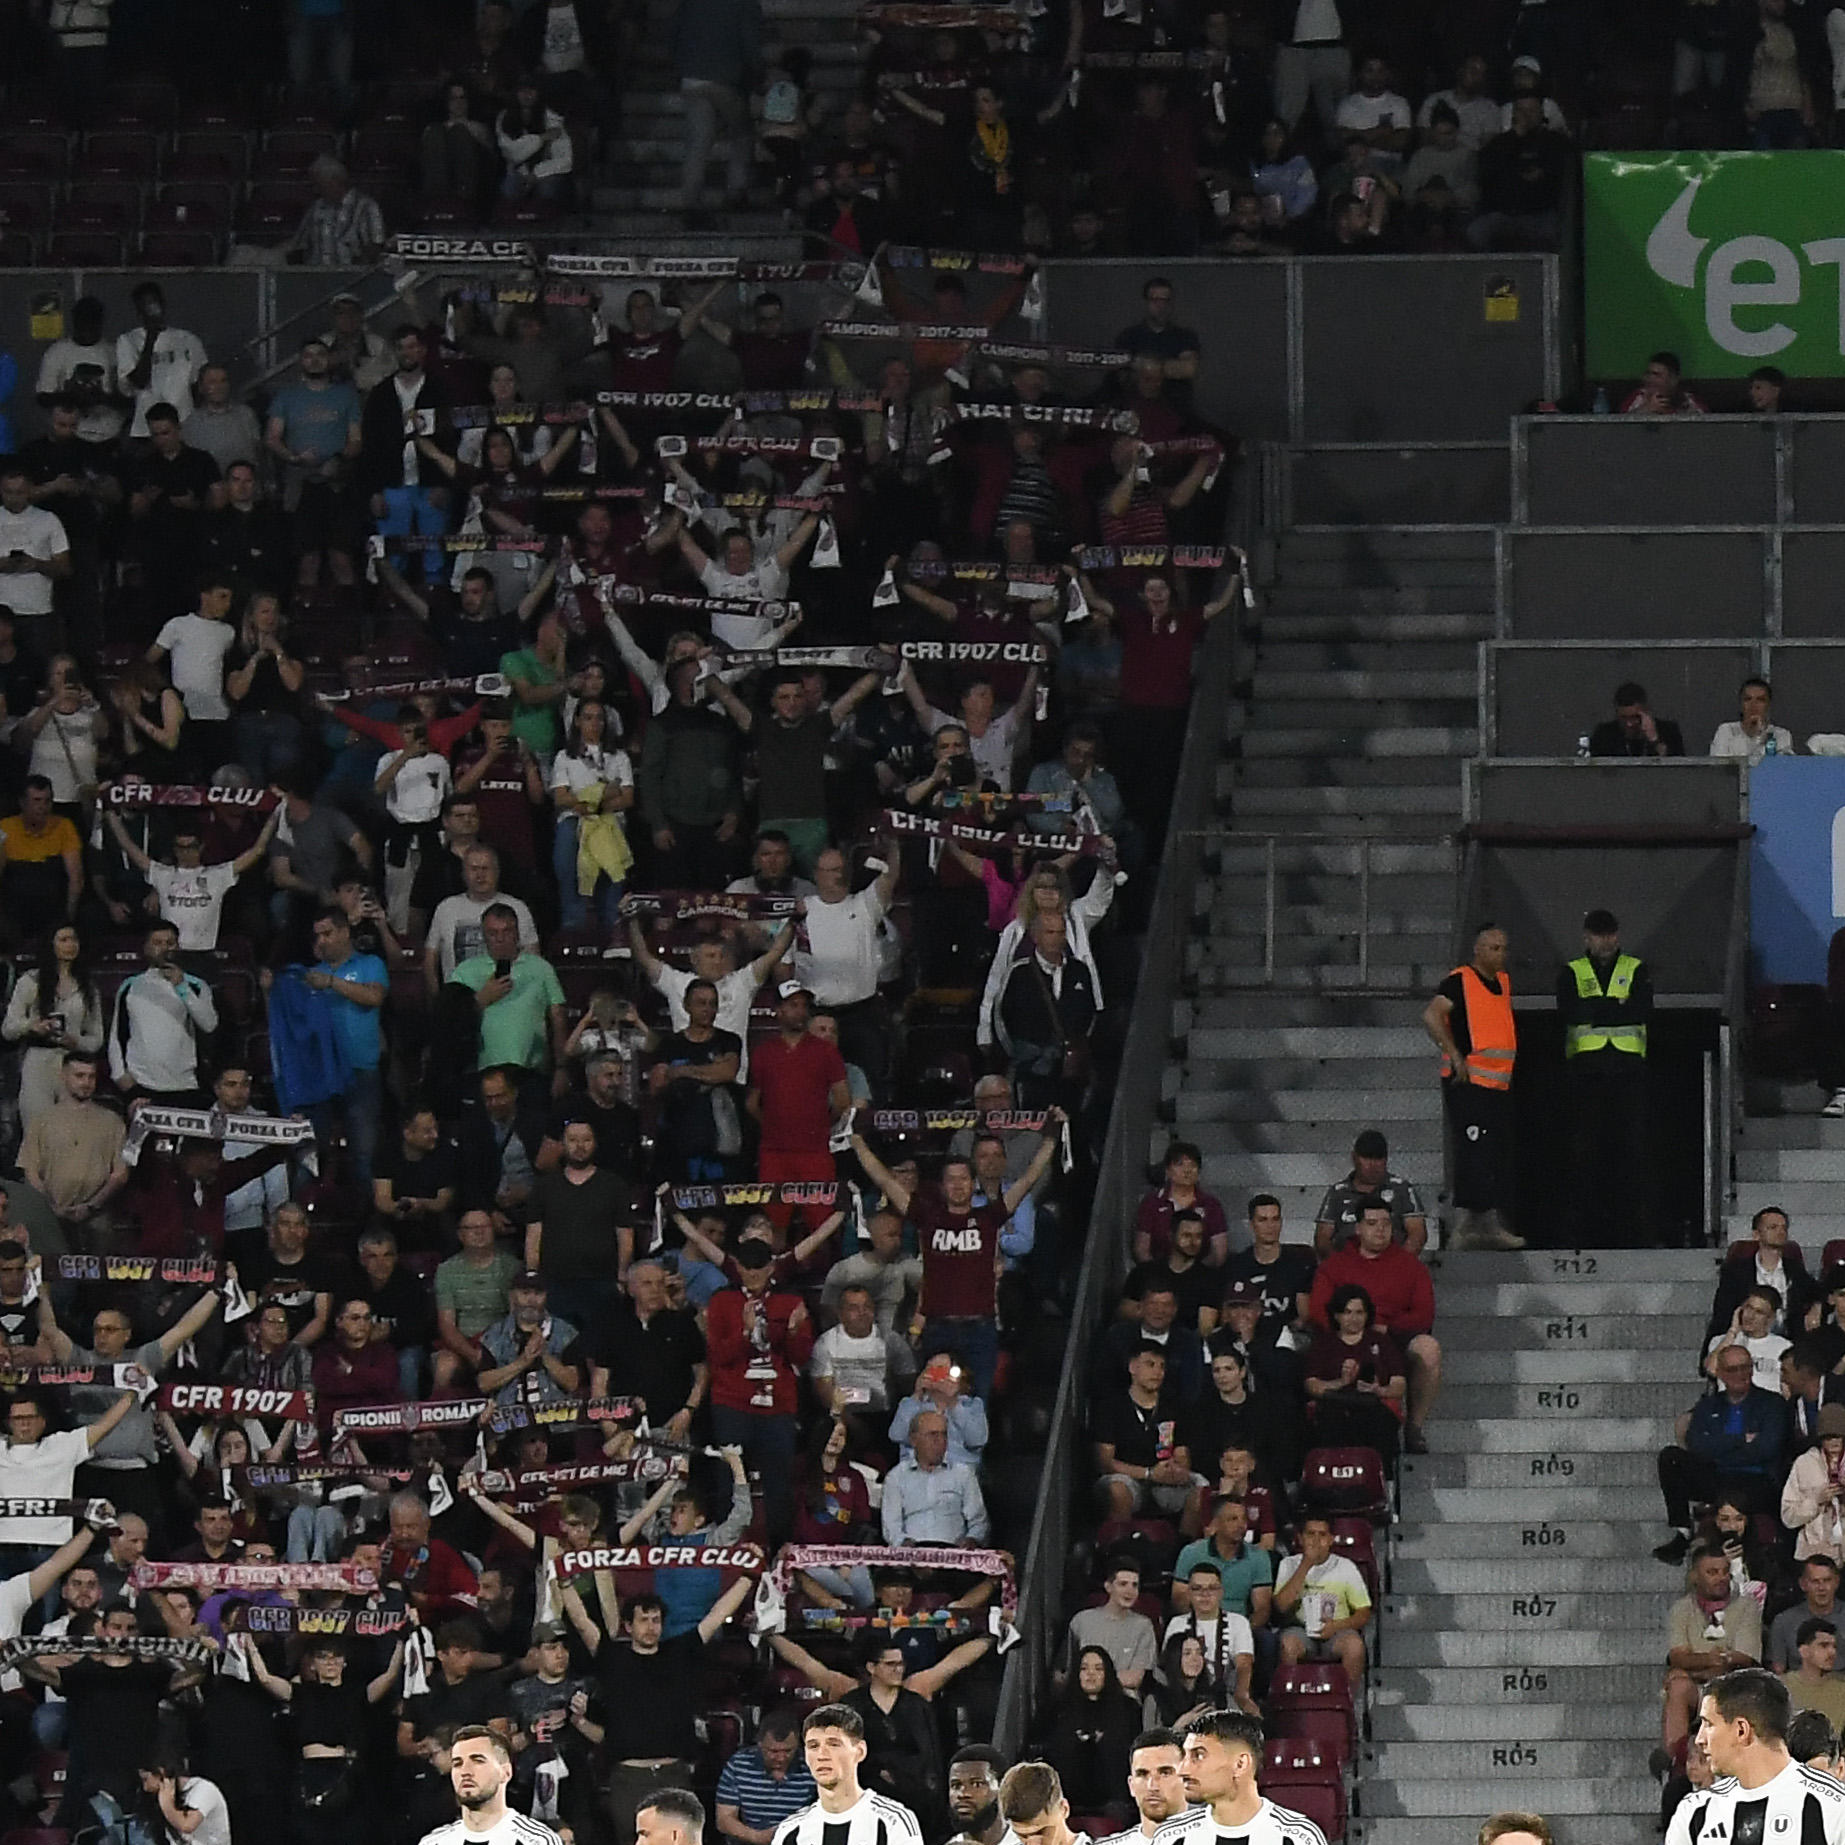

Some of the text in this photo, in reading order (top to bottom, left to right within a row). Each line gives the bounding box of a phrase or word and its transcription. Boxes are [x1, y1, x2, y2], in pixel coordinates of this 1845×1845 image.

[900, 641, 944, 660] CFR
[948, 642, 999, 661] 1907
[109, 784, 265, 807] CFR CLUJ
[1546, 1322, 1589, 1339] R11
[171, 1385, 294, 1415] CFR 1907
[1537, 1391, 1580, 1409] R10
[579, 1465, 601, 1480] DE
[602, 1463, 630, 1478] MIC
[1522, 1528, 1566, 1546] R08
[562, 1546, 762, 1572] FORZA CFR CLUJ
[1511, 1599, 1557, 1617] R07
[1503, 1674, 1548, 1692] R06
[1492, 1748, 1538, 1767] R05
[1799, 1779, 1843, 1803] AROBS
[1773, 1819, 1787, 1833] U
